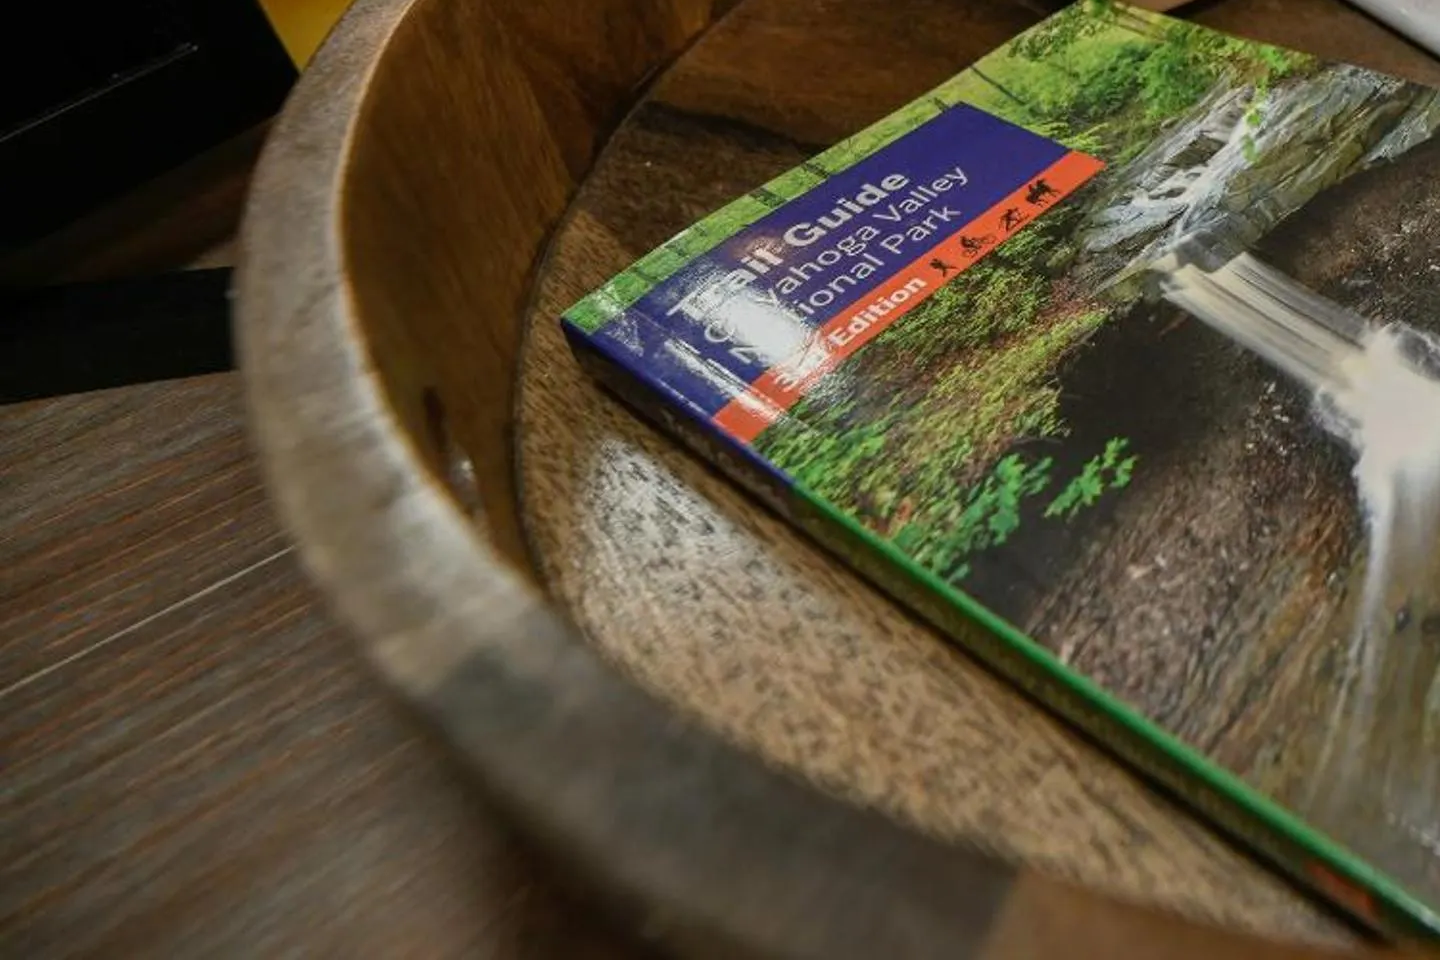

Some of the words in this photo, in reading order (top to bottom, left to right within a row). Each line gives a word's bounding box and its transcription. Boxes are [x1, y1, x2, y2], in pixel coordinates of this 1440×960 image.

[704, 224, 880, 343] Cyahoga
[873, 166, 969, 222] Valley
[783, 171, 910, 247] Guide
[729, 252, 885, 364] Nional
[881, 205, 962, 253] Park
[772, 330, 831, 392] 3d
[829, 276, 927, 346] Edition
